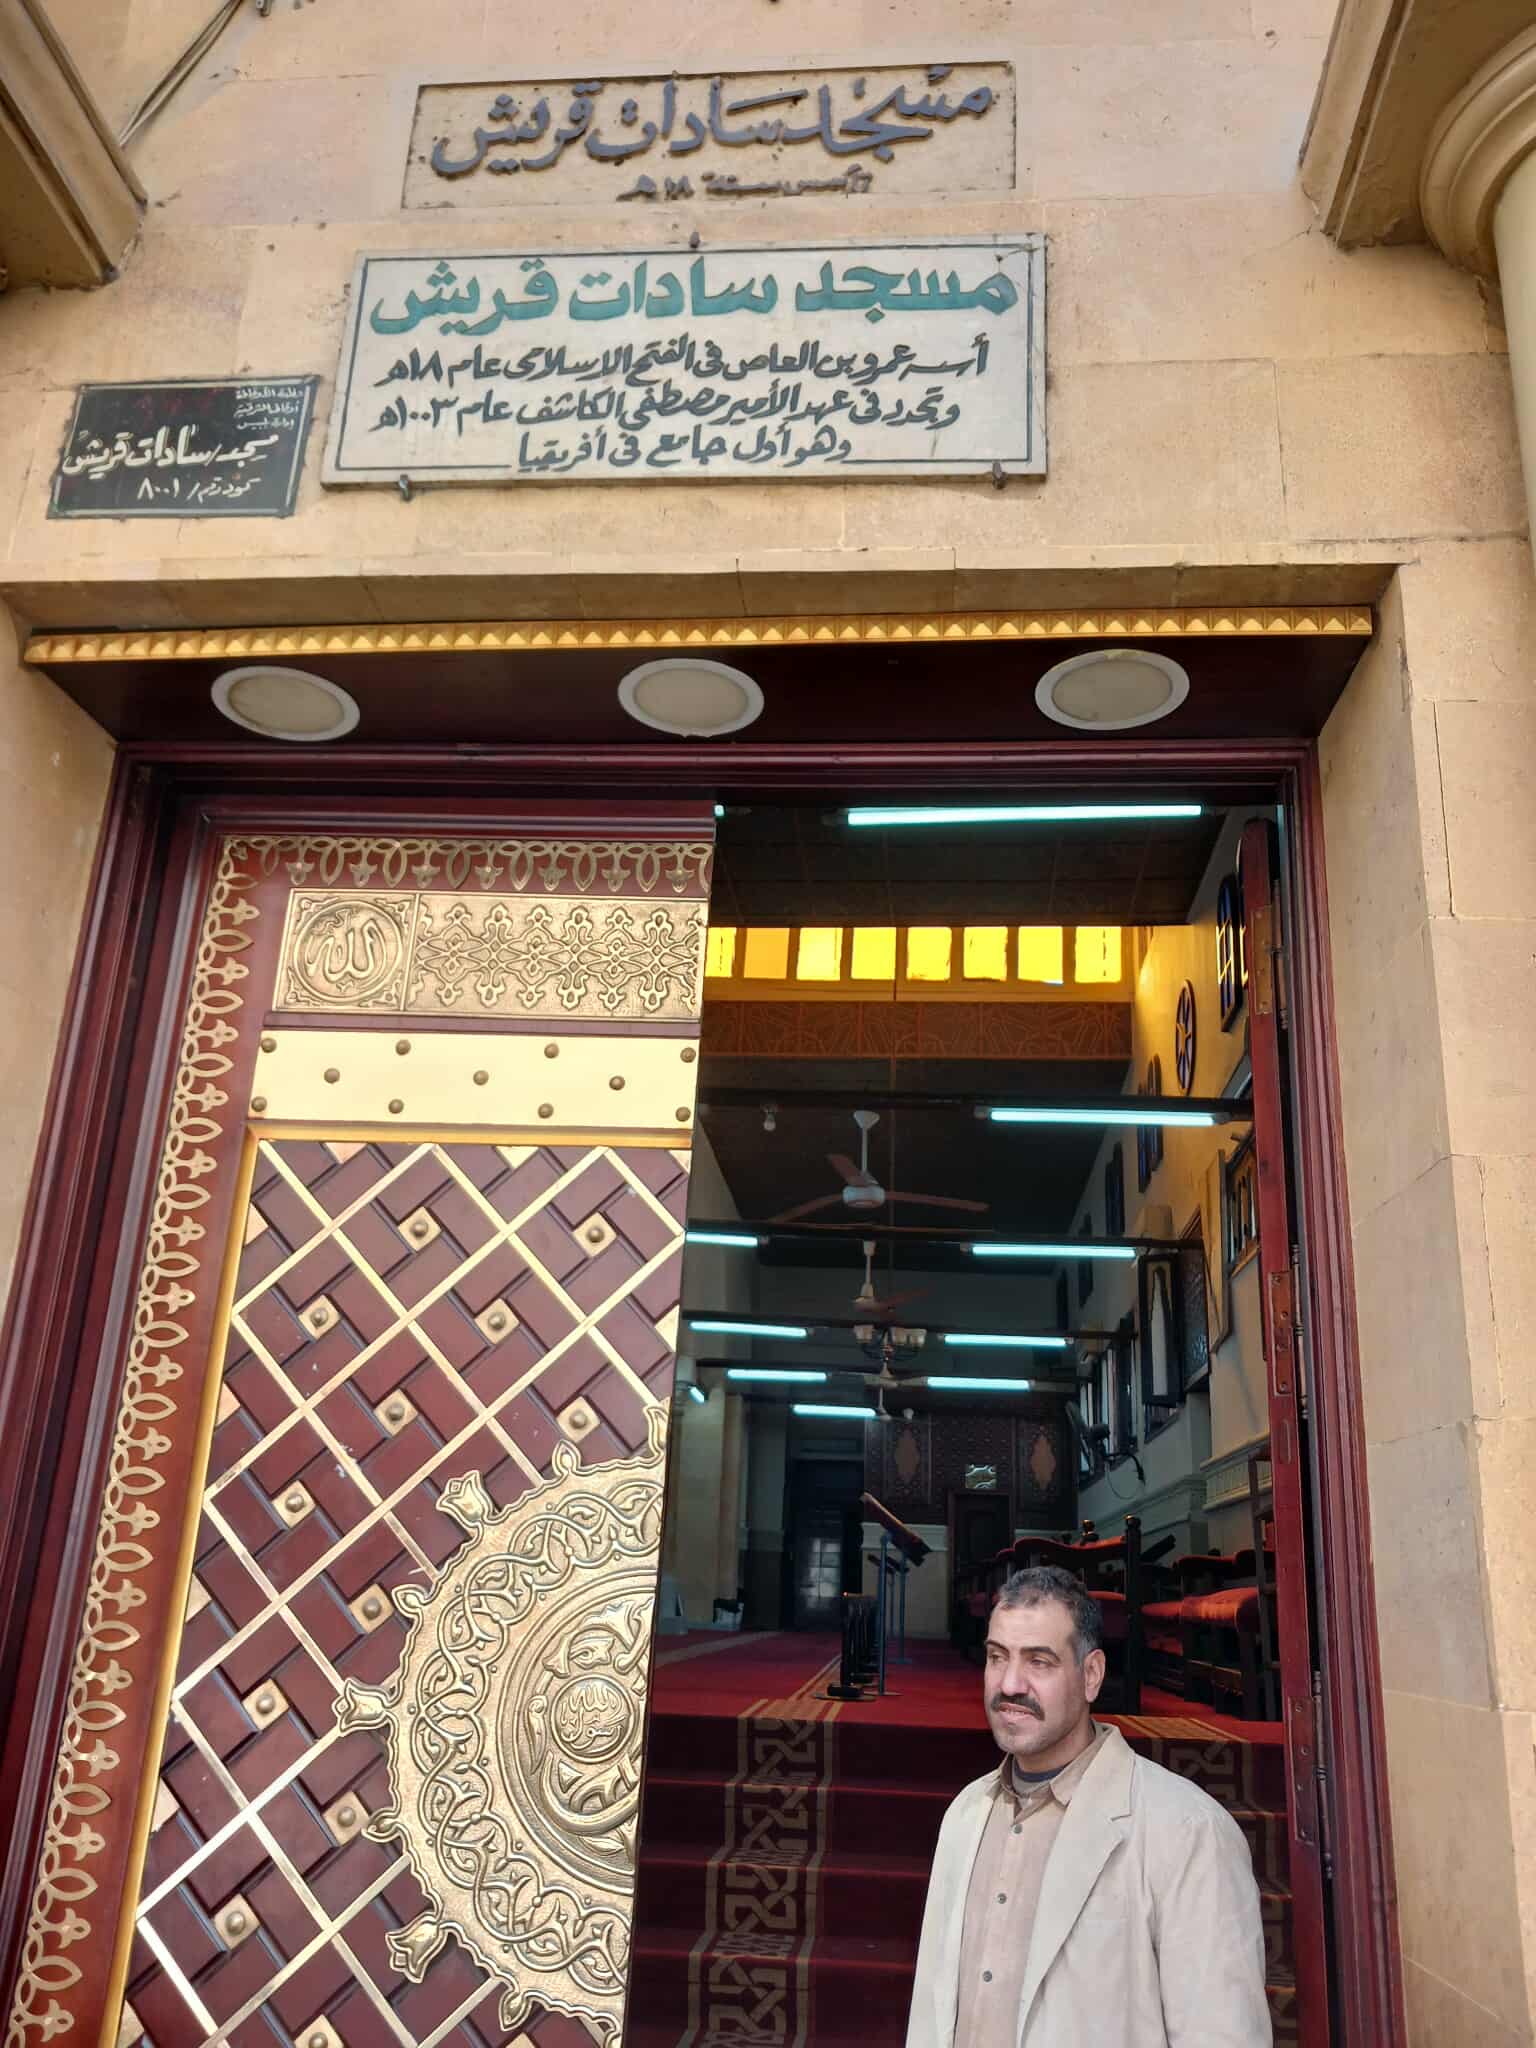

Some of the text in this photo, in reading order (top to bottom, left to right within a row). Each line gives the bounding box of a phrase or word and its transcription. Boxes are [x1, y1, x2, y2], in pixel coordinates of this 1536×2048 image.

[431, 64, 993, 180] مسجد سادات قريش
[369, 256, 1018, 336] مسجد سادات قريش
[447, 343, 502, 389] عام
[625, 331, 696, 387] الفتح
[722, 340, 820, 381] العاص
[852, 344, 917, 386] عمرو
[456, 388, 513, 438] عام
[515, 386, 626, 425] الكاشف
[708, 378, 802, 426] الأمير
[783, 389, 854, 425] عهد
[61, 431, 133, 481] قريش
[124, 423, 208, 467] سادات
[646, 423, 728, 468] جامع
[733, 421, 792, 464] أول
[783, 424, 852, 468] وهو
